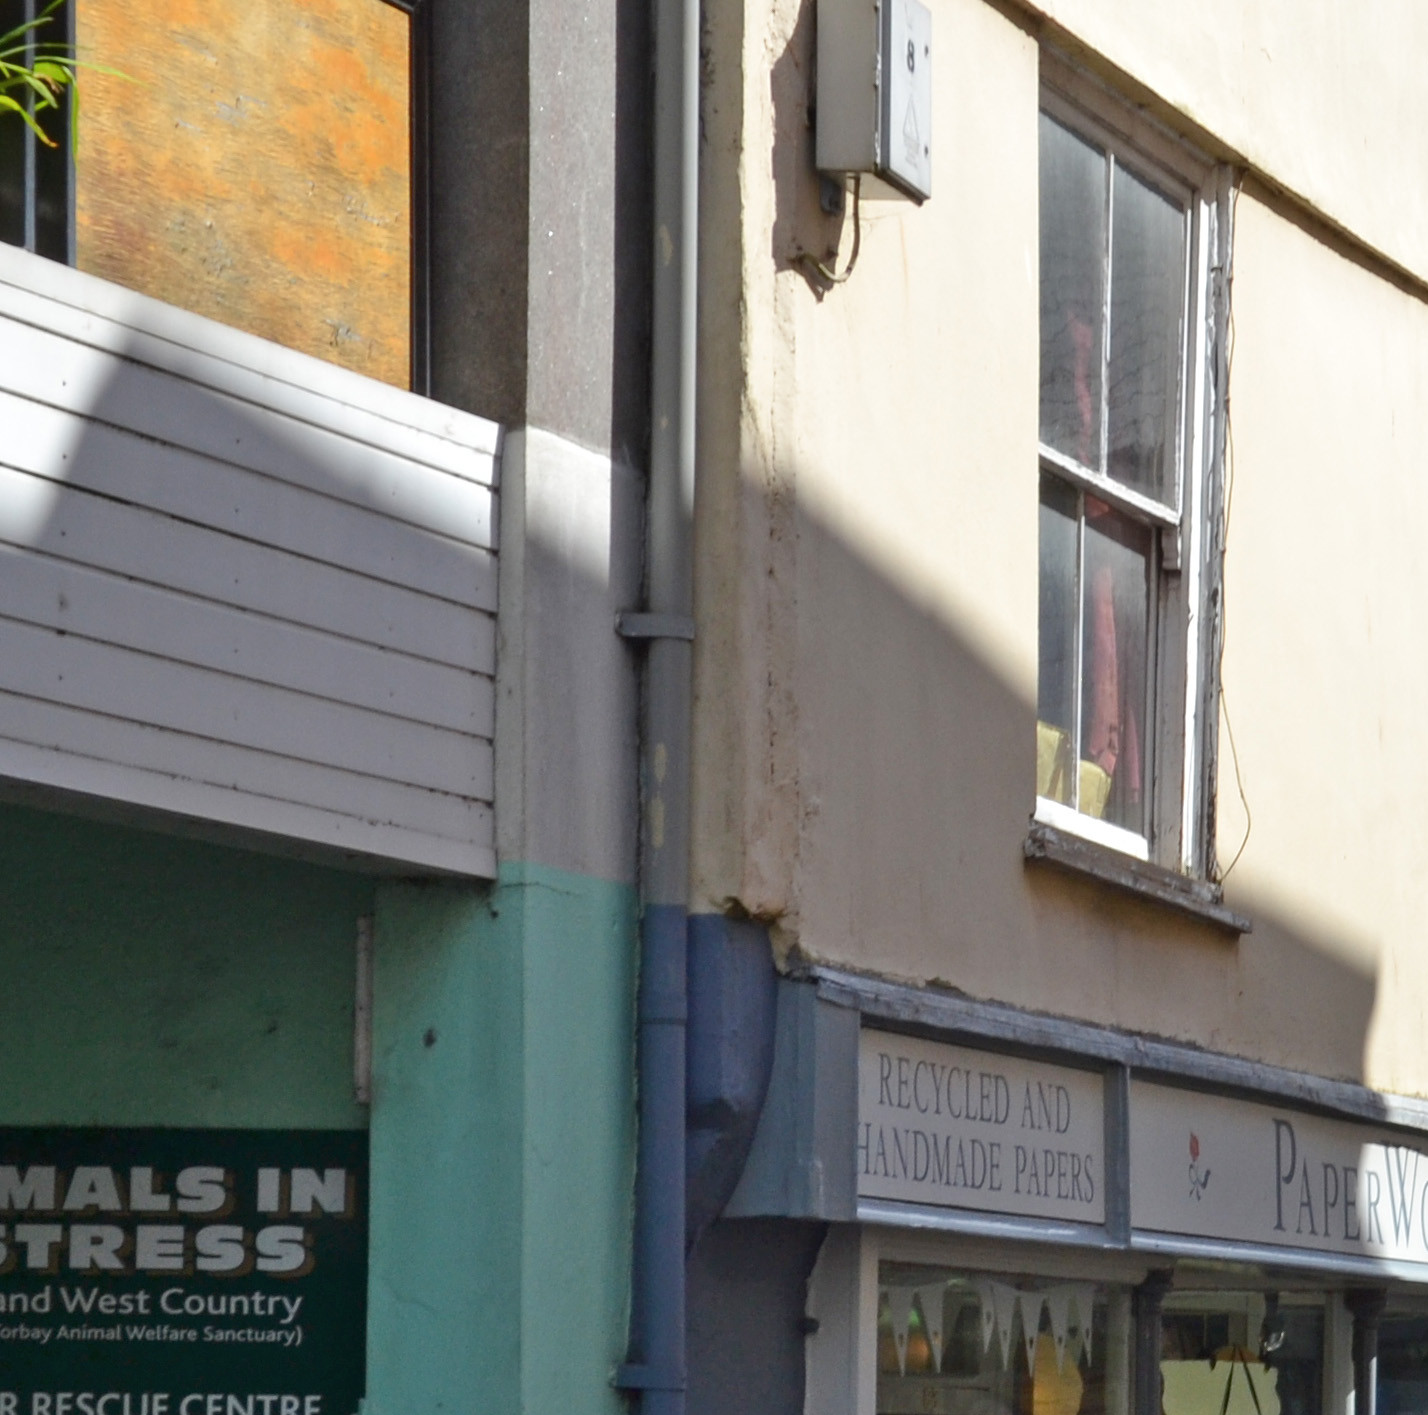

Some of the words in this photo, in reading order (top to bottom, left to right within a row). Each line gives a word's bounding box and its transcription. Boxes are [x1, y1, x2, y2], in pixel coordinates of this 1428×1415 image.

[877, 1054, 1010, 1124] RECYCLED
[1021, 1081, 1071, 1134] AND
[857, 1120, 1003, 1192] HANDMADE
[1014, 1144, 1095, 1204] PAPERS
[256, 1166, 346, 1214] IN
[0, 1224, 306, 1273] TRESS
[60, 1287, 150, 1316] West
[160, 1287, 303, 1324] Country
[56, 1324, 122, 1342] Animal
[126, 1325, 197, 1342] Welfare
[203, 1325, 303, 1347] Sanctuary)
